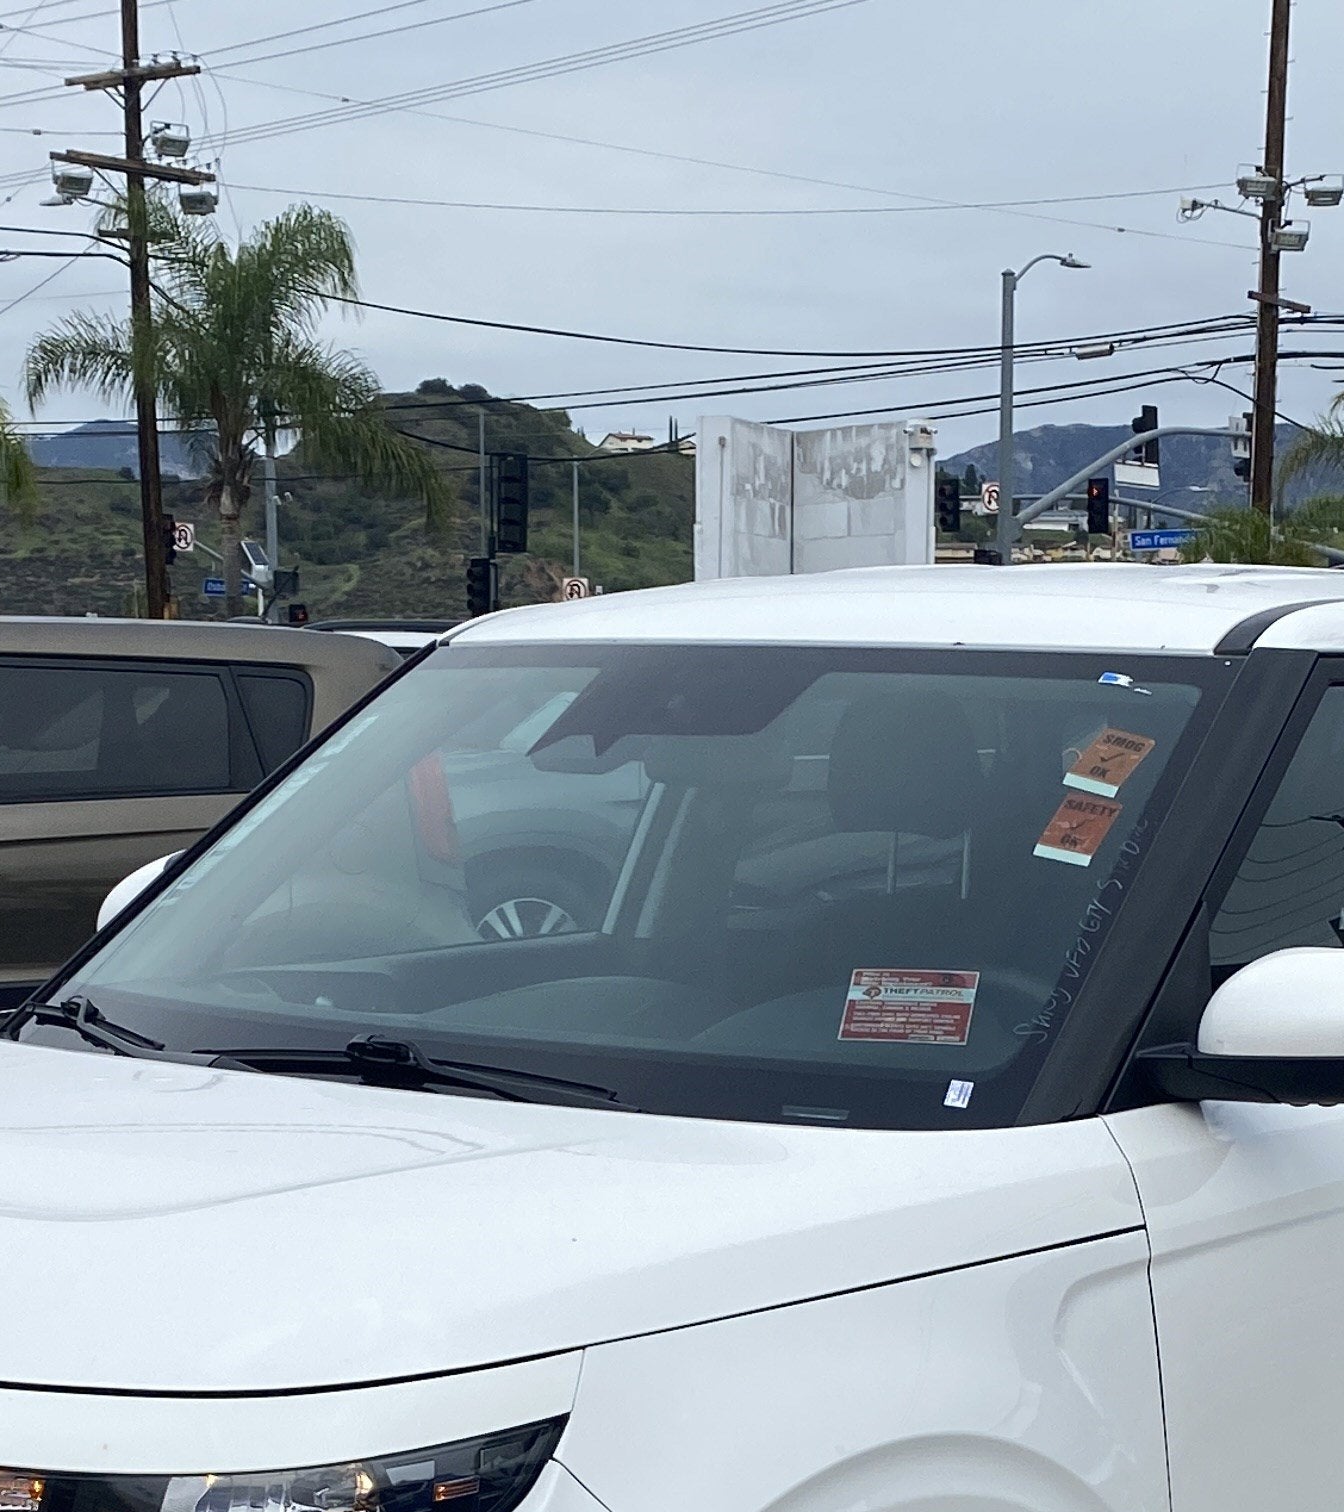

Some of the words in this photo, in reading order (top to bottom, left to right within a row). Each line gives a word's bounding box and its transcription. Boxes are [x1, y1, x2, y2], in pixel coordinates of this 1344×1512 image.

[1134, 535, 1152, 547] San
[1102, 733, 1145, 753] SMOG
[1090, 764, 1111, 779] OK
[1064, 799, 1119, 818] SAFETY
